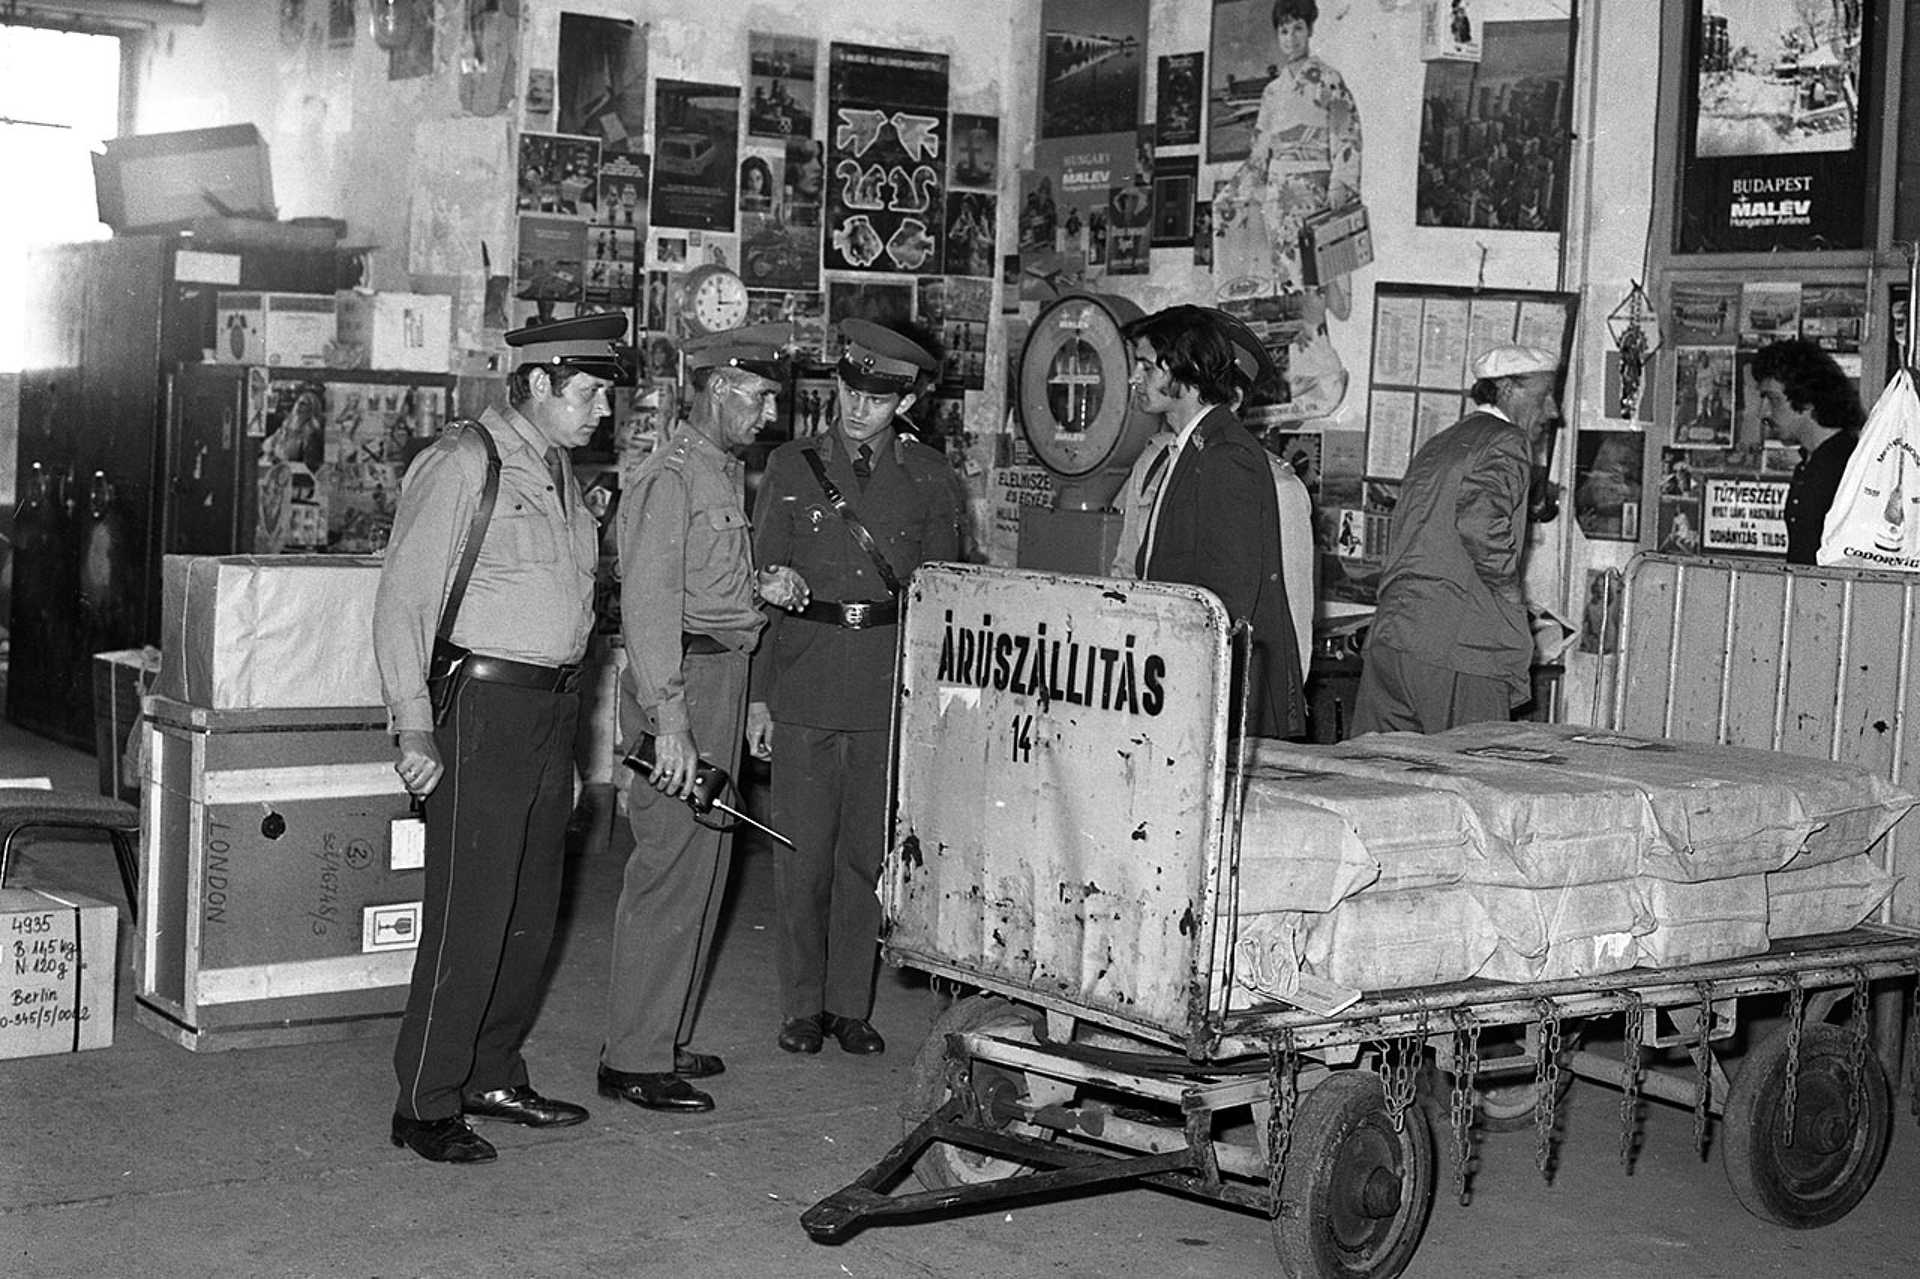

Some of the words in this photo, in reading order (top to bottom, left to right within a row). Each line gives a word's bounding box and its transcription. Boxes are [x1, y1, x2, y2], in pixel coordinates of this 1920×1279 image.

[1732, 176, 1813, 194] BUDAPEST
[1761, 531, 1787, 548] TILOS
[1011, 714, 1034, 763] 14
[206, 821, 231, 925] LONDON
[11, 914, 55, 934] 4935
[13, 940, 25, 958] B
[16, 958, 26, 976] N
[11, 988, 58, 1006] Berlin
